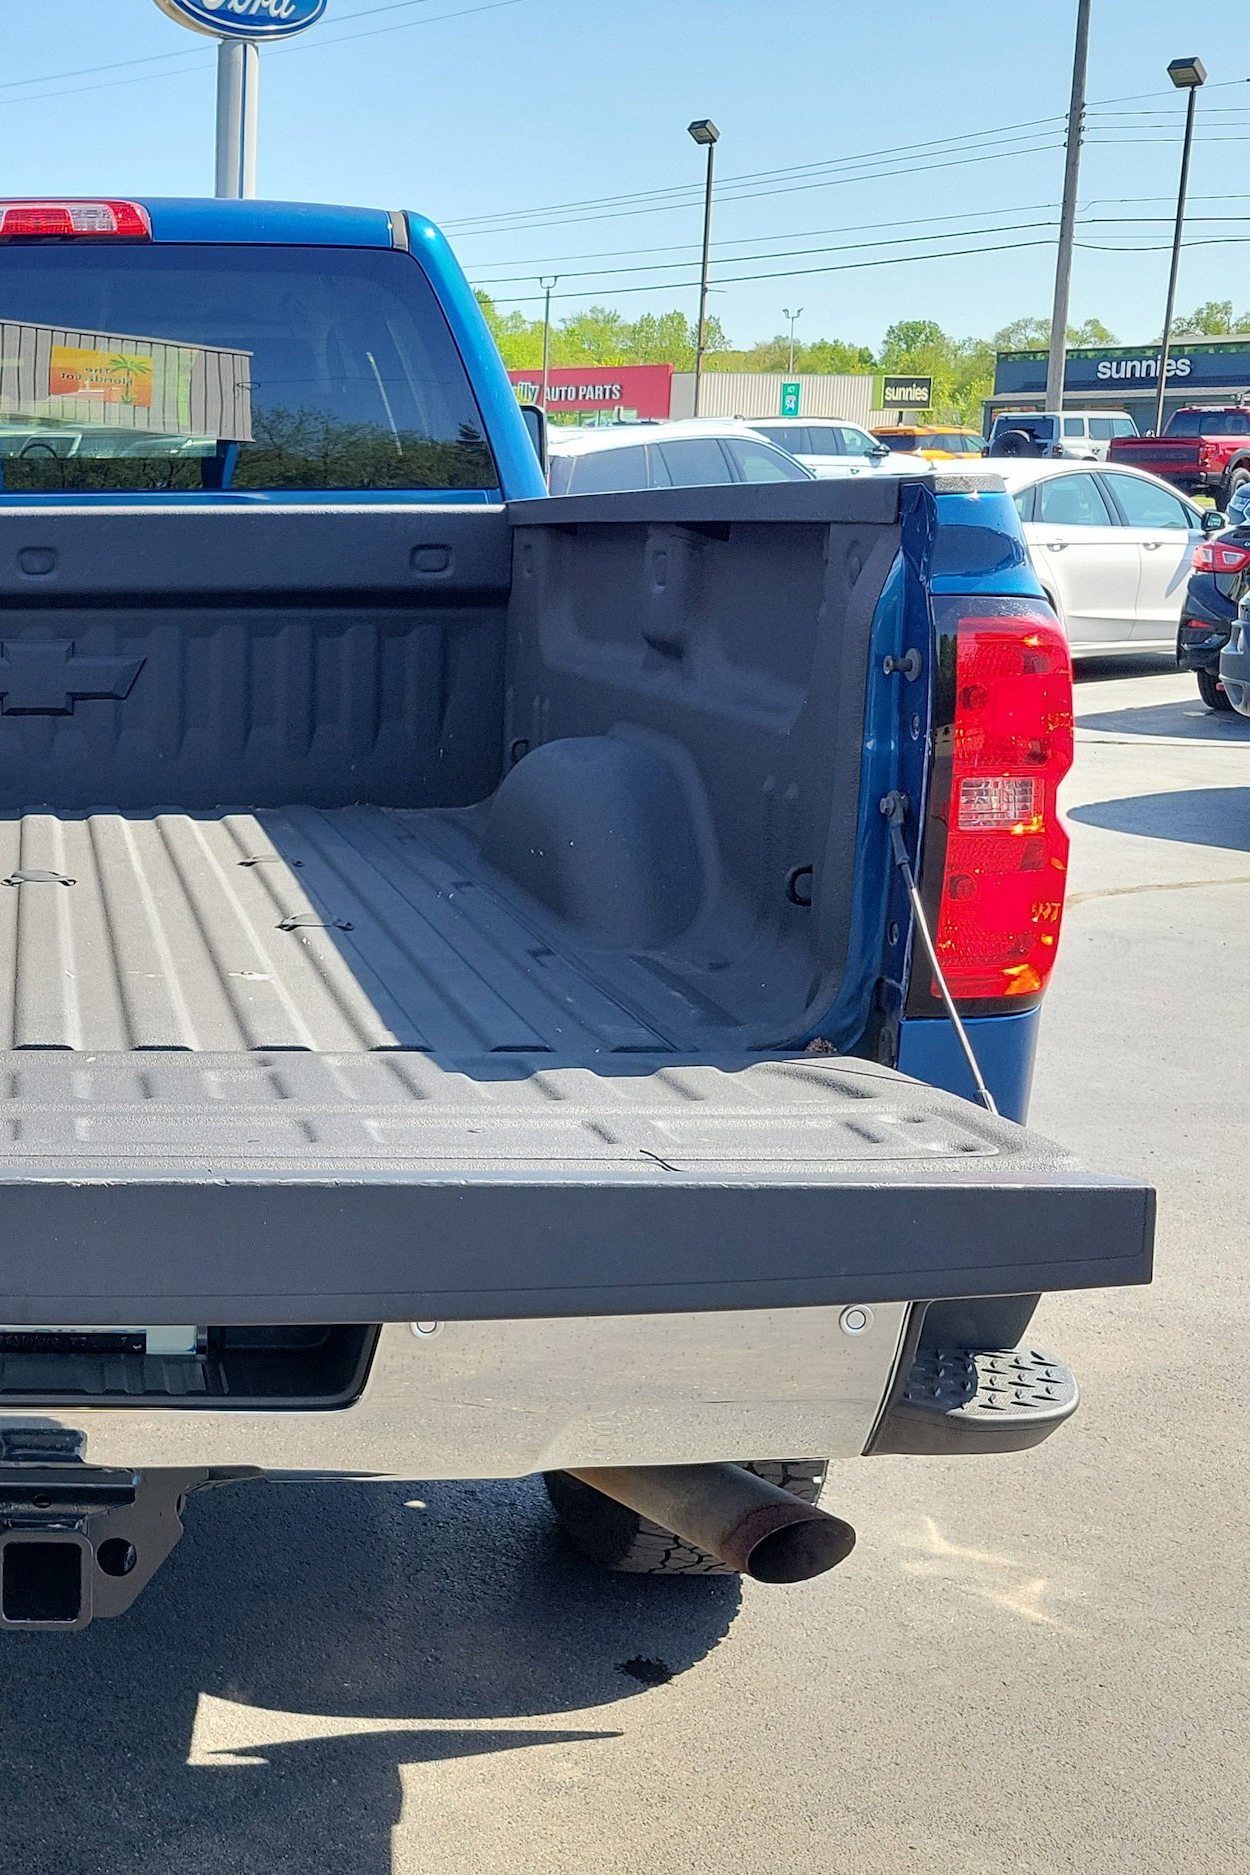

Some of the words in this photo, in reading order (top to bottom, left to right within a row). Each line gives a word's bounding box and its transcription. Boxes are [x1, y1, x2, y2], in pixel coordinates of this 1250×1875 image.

[1096, 354, 1191, 380] sunnies
[545, 386, 577, 401] AUTO
[578, 384, 622, 400] PARTS
[884, 382, 929, 401] sunnies
